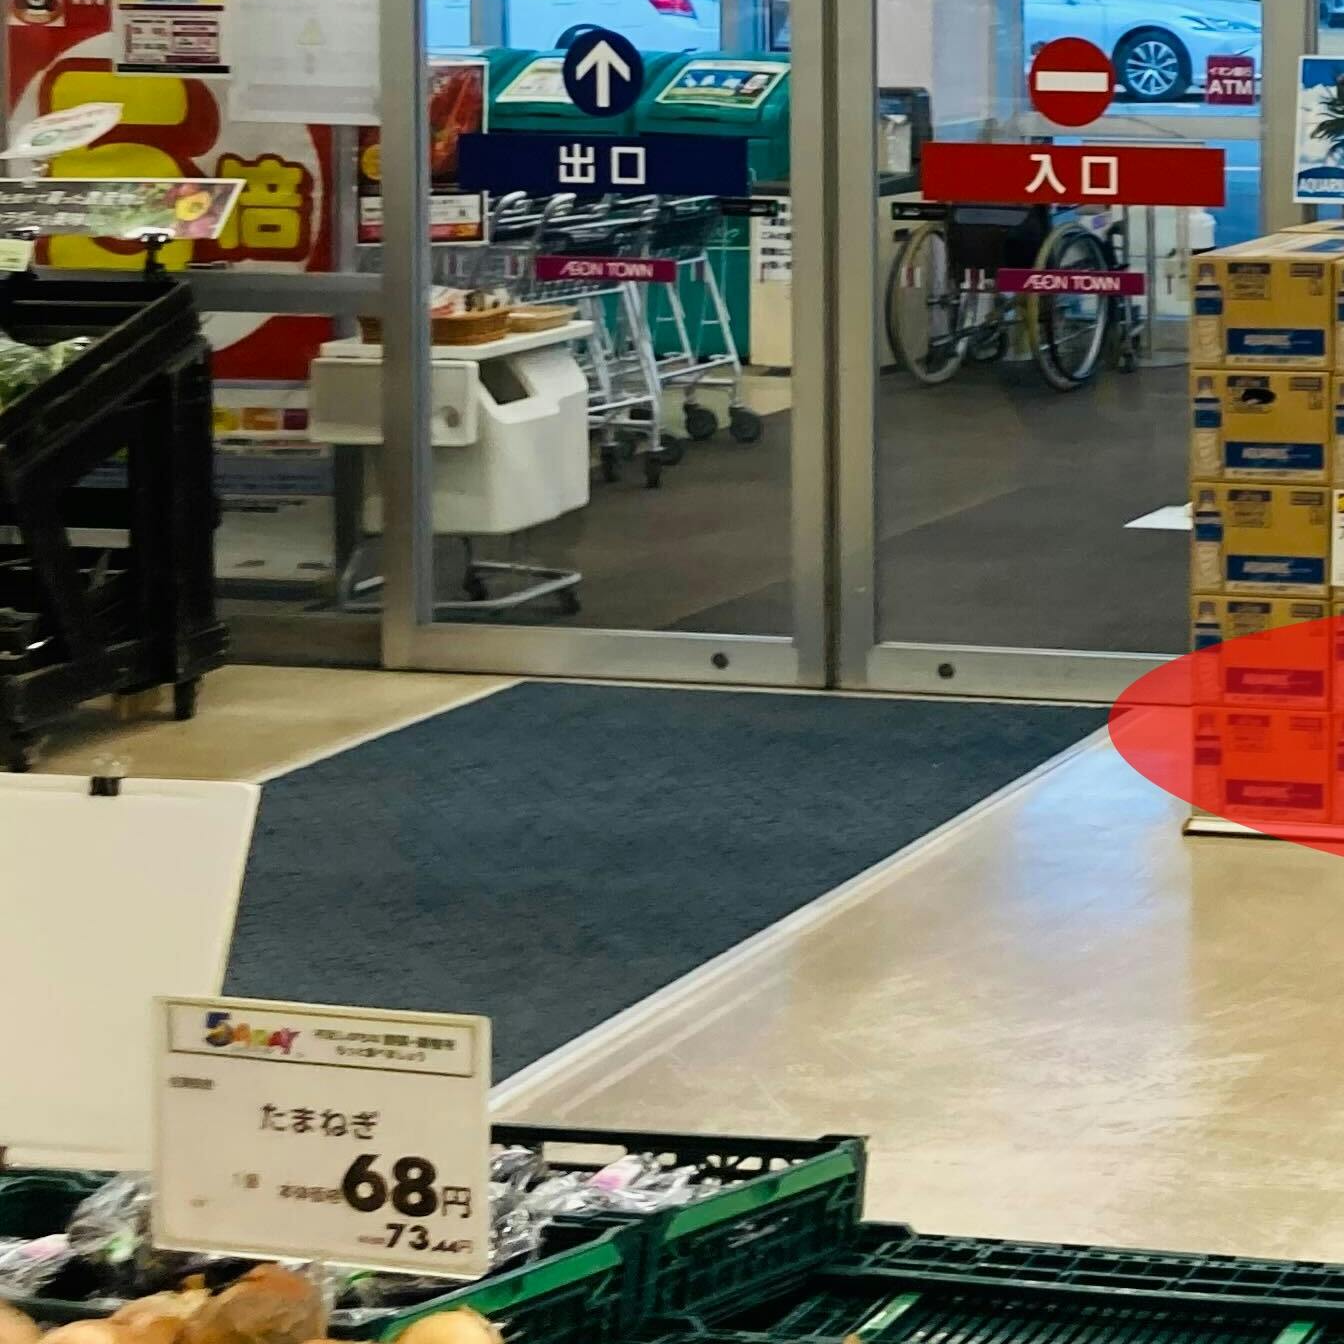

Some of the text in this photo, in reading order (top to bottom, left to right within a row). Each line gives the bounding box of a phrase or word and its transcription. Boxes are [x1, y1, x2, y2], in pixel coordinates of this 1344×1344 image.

[1208, 79, 1253, 95] ATM
[559, 143, 646, 185] 出口
[1024, 153, 1119, 196] 入口
[606, 261, 654, 278] TOWN
[1071, 275, 1121, 291] TOWN
[259, 1103, 380, 1141] たまねぎ
